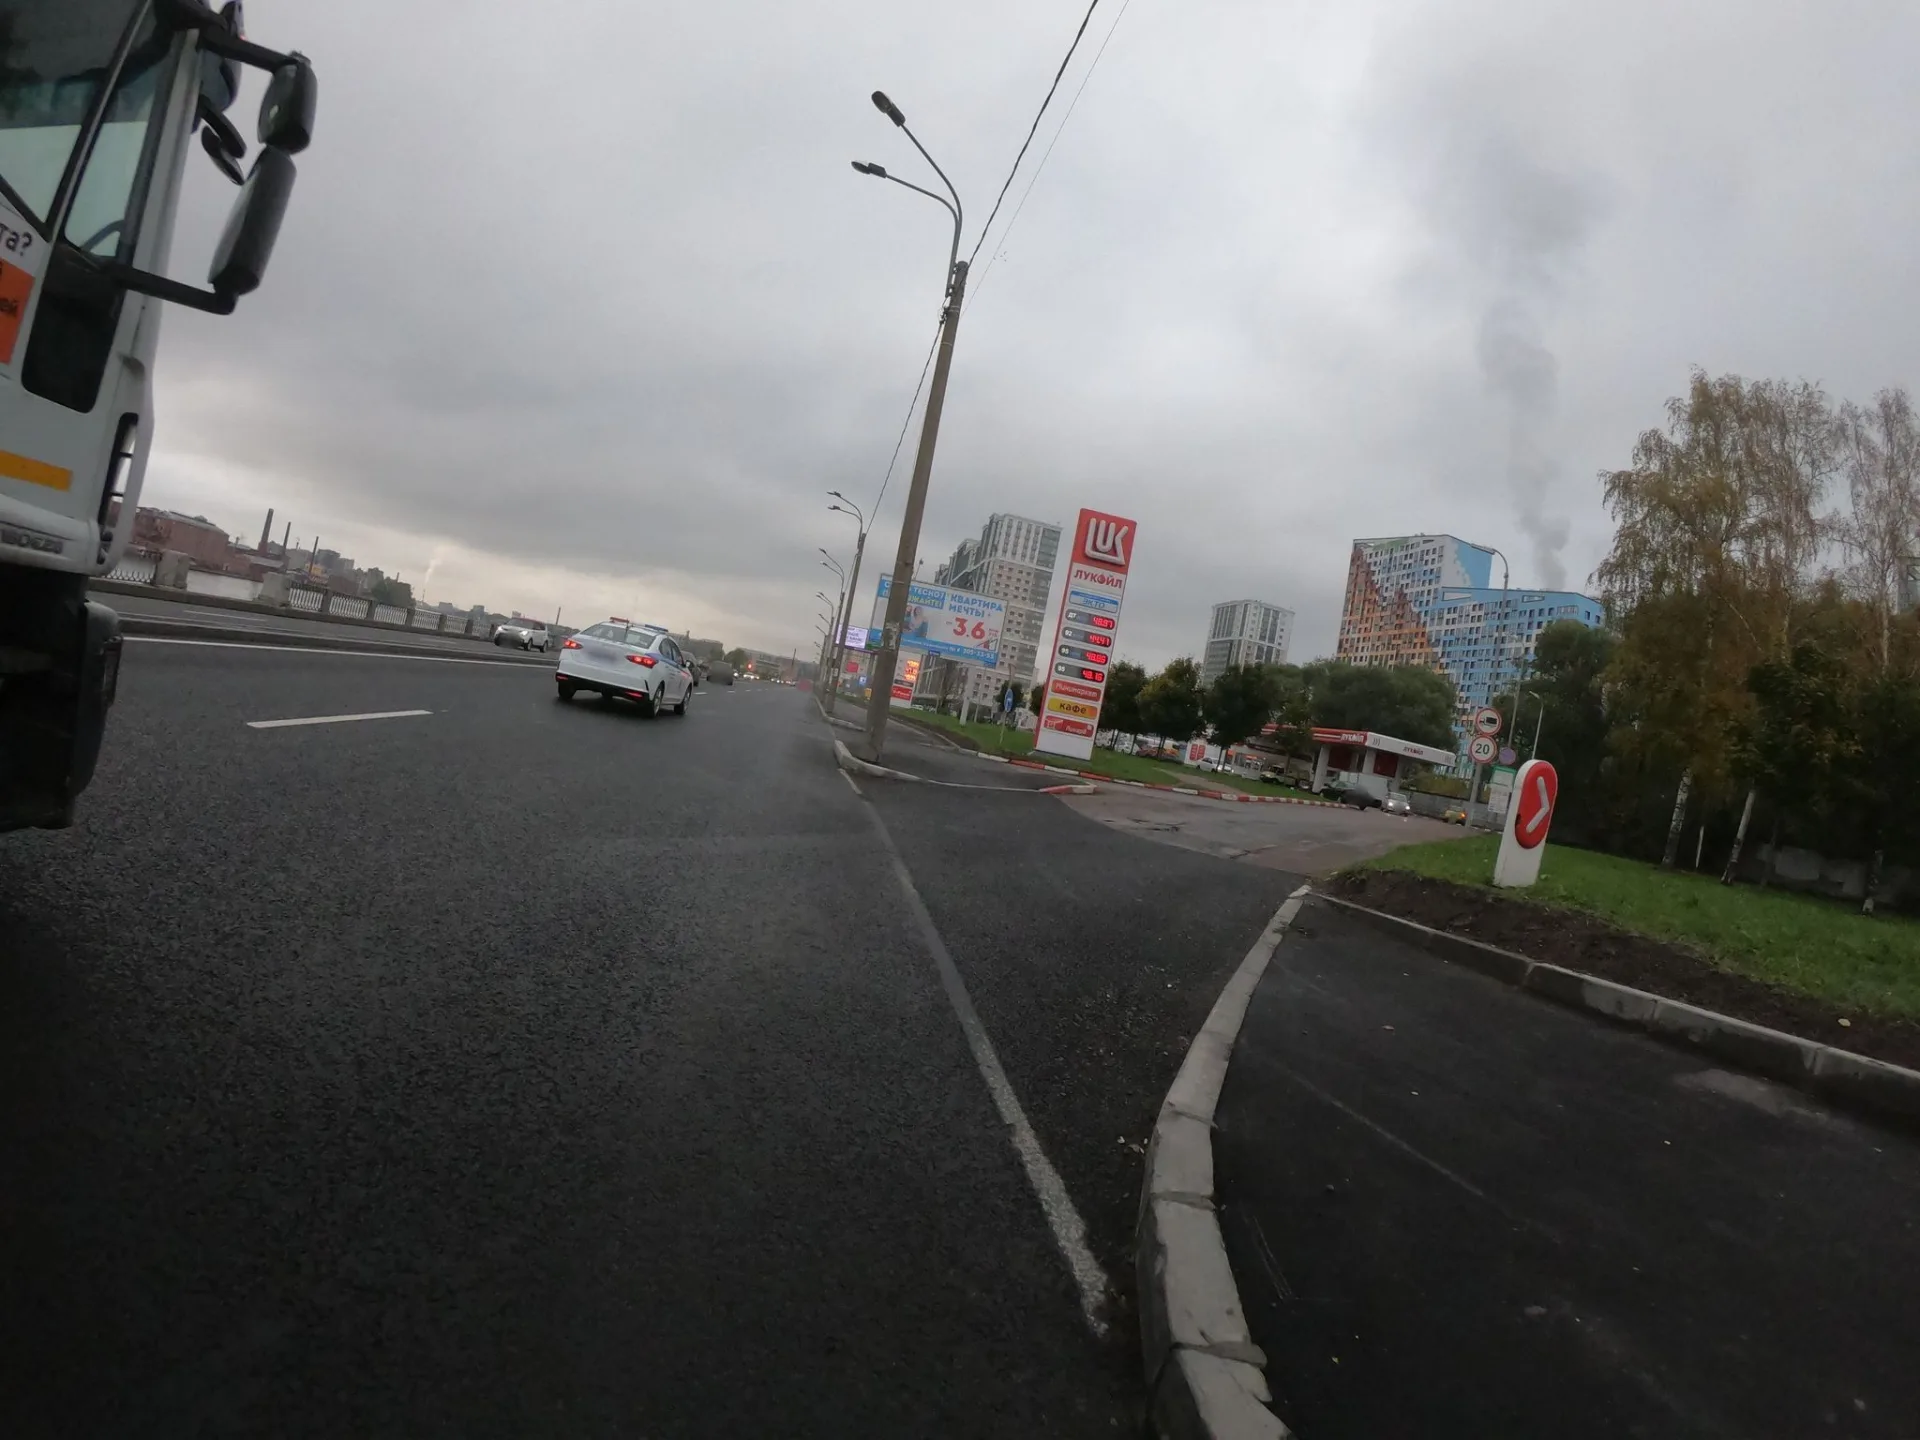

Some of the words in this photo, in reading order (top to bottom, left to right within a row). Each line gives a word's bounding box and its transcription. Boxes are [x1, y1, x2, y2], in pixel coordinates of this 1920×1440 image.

[1074, 568, 1122, 589] ЛУКОЙЛ
[949, 603, 985, 618] МЕЧТЫ
[950, 594, 1003, 612] КВАРТИРА
[953, 616, 986, 639] 3.6
[1064, 629, 1073, 637] 92
[1059, 702, 1088, 714] кафе
[1474, 743, 1490, 756] 20
